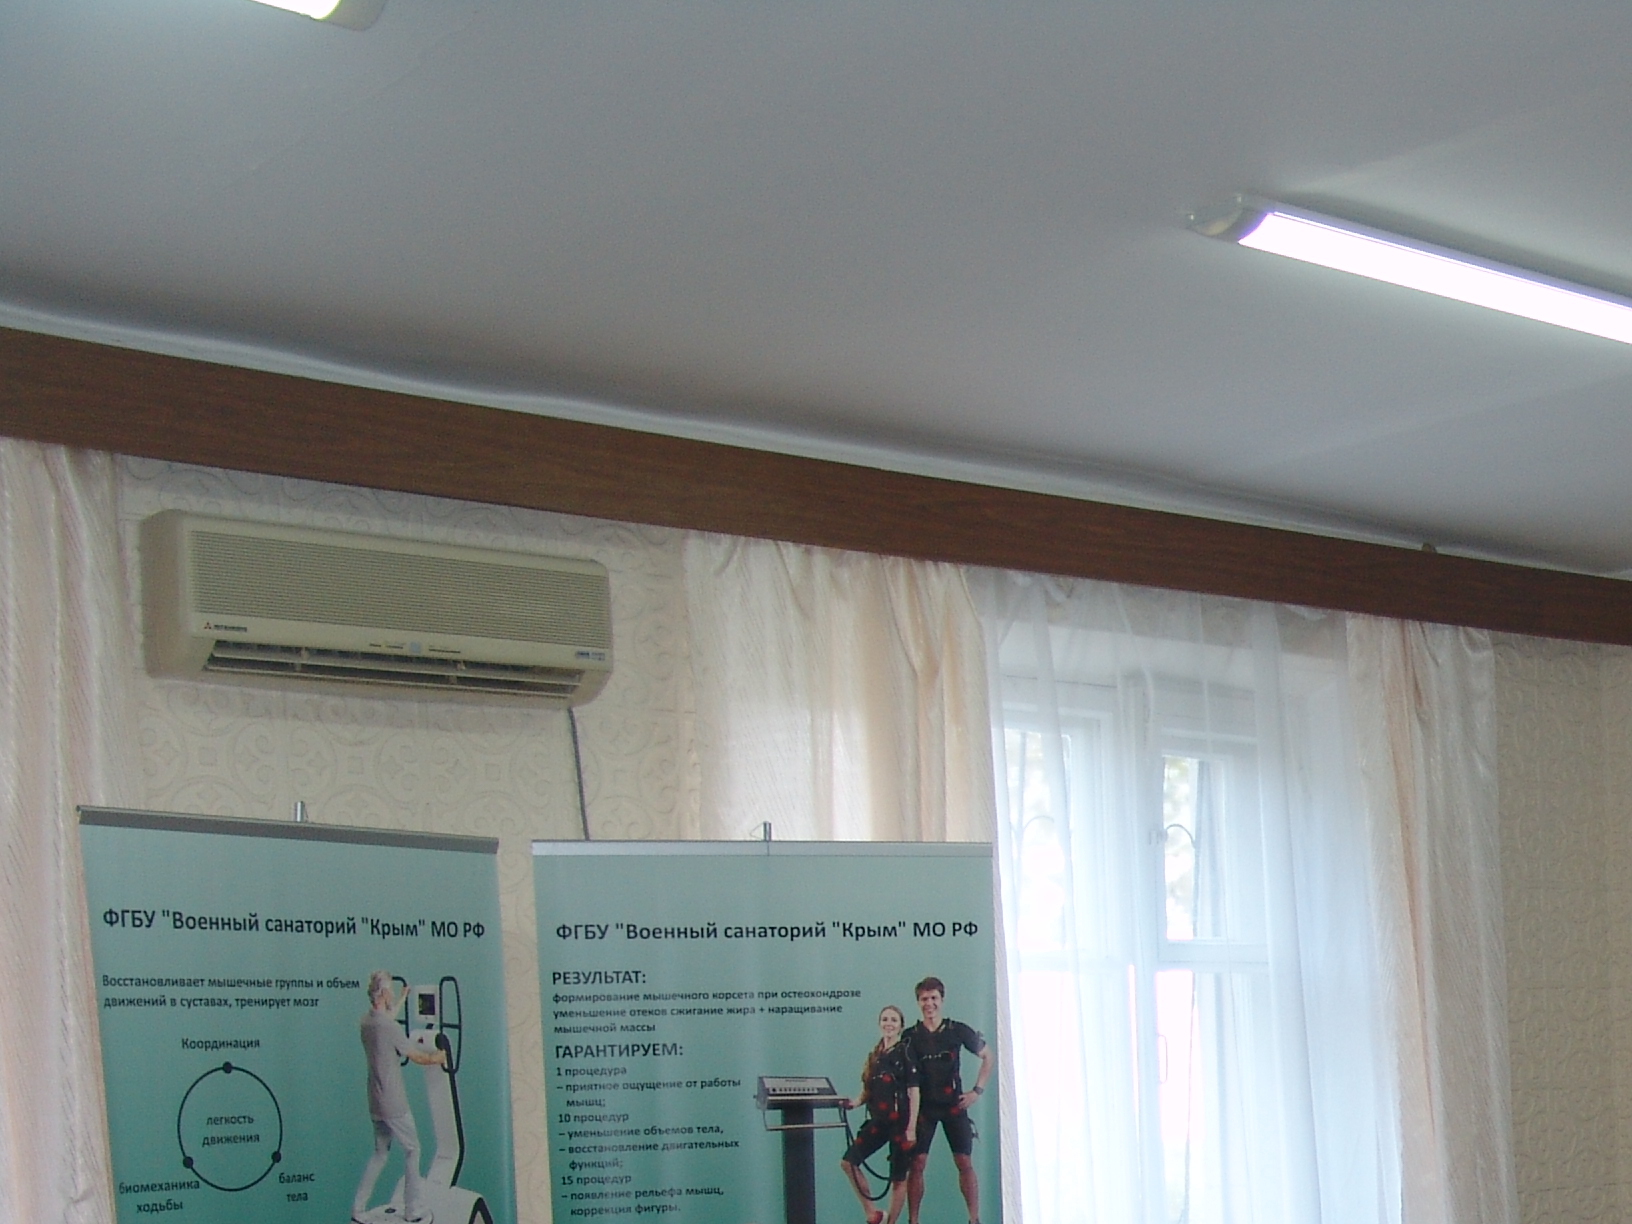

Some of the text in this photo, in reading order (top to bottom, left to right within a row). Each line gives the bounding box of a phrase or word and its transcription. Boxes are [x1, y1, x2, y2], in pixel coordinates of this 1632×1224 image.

[103, 908, 485, 940] ФГБУ "Военный санаторий "Крым" МО РФ
[556, 921, 978, 941] ФГБУ "Военный санаторий "Крым" МО РФ
[102, 974, 360, 990] Восстановливает мышечные группы и объем
[552, 970, 646, 985] РЕЗУЛЬТАТ:
[103, 995, 319, 1009] движений в суставах, тренирует мозг
[552, 988, 861, 1004] формирование мышечного корсета при остеохондрозе
[553, 1008, 626, 1019] уменьшение
[670, 1006, 723, 1017] сжигание
[726, 1005, 756, 1016] жира
[767, 1004, 843, 1015] наращивание
[554, 1023, 656, 1034] мышечной массы
[181, 1038, 260, 1051] Координация
[555, 1043, 683, 1059] ГАРАНТИРУЕМ:
[556, 1066, 627, 1078] 1 процедура
[565, 1083, 619, 1093] приятное
[622, 1080, 683, 1092] ощущение
[685, 1080, 697, 1089] от
[700, 1077, 741, 1089] работы
[206, 1114, 254, 1126] легкость
[558, 1113, 629, 1124] 10 процедур
[567, 1127, 641, 1139] уменьшение
[643, 1125, 694, 1136] объемов
[696, 1125, 724, 1136] тела,
[201, 1133, 260, 1148] движения
[568, 1142, 659, 1154] восстановление
[661, 1140, 740, 1152] двигательных
[278, 1171, 316, 1184] баланс
[561, 1174, 632, 1186] 15 процедур
[119, 1179, 200, 1195] биомеханика
[570, 1191, 632, 1201] появление
[634, 1187, 682, 1199] рельефа
[286, 1192, 308, 1203] тела
[136, 1198, 183, 1214] ходьбы
[570, 1202, 681, 1217] коррекция фигуры.
